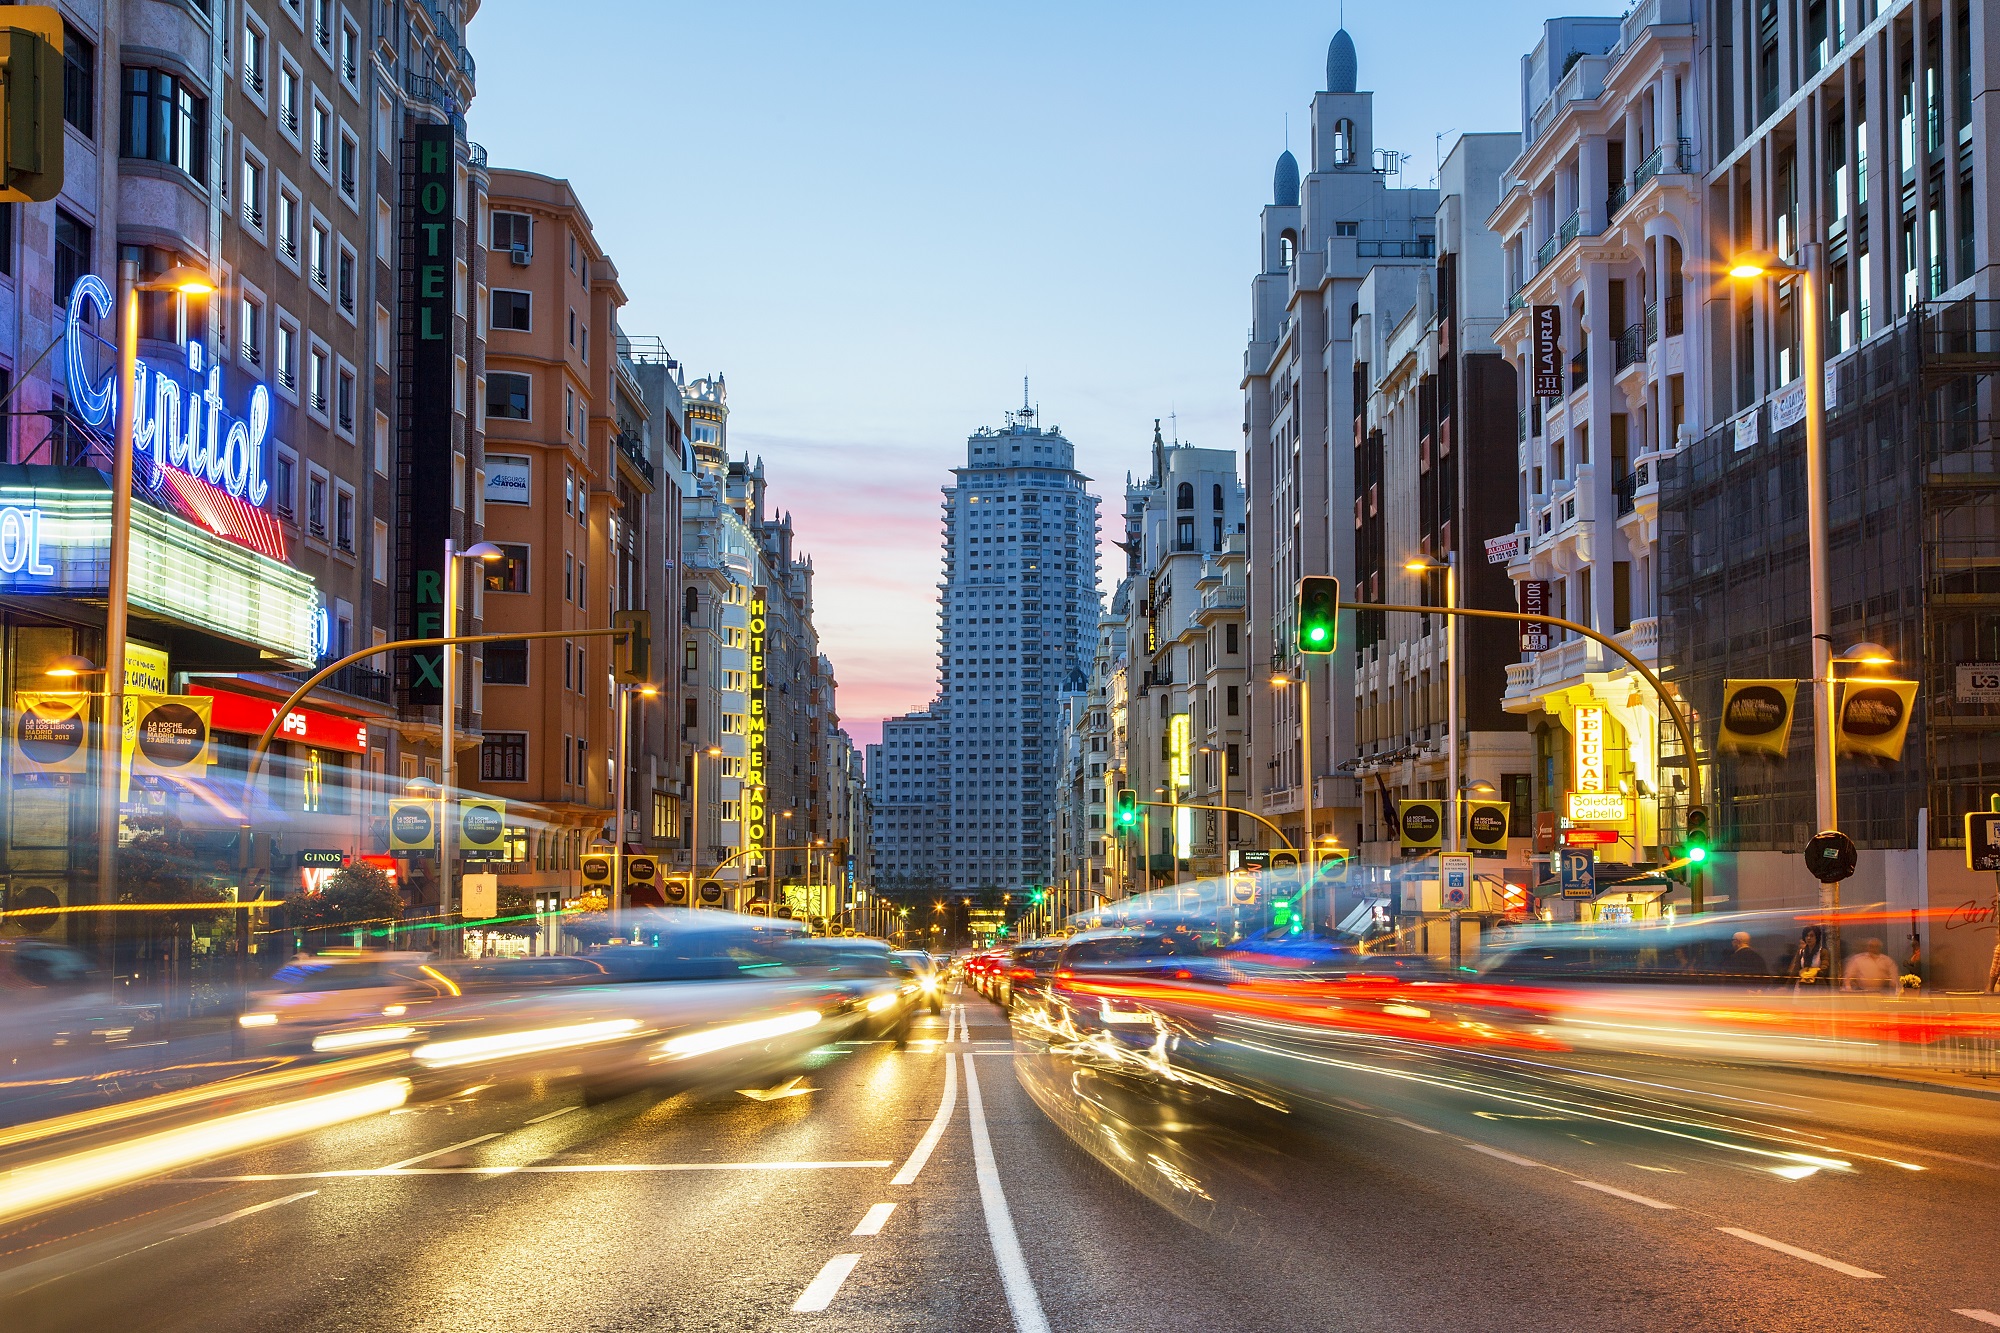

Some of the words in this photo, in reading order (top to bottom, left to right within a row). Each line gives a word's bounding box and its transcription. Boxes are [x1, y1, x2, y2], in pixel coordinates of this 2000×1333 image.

[421, 139, 447, 340] HOTEL
[1541, 308, 1554, 374] LAURIA
[64, 273, 270, 507] Capitol
[1488, 542, 1517, 554] ALQUILA
[412, 570, 443, 688] REX
[1527, 582, 1541, 634] EXELSIOR
[751, 600, 765, 689] HOTEL
[750, 699, 764, 860] EMPERADOR
[1581, 708, 1599, 791] PELUCAS
[1574, 796, 1623, 806] Soledad
[1576, 808, 1622, 818] Cabello
[304, 852, 340, 862] GINOS
[1570, 856, 1588, 882] P
